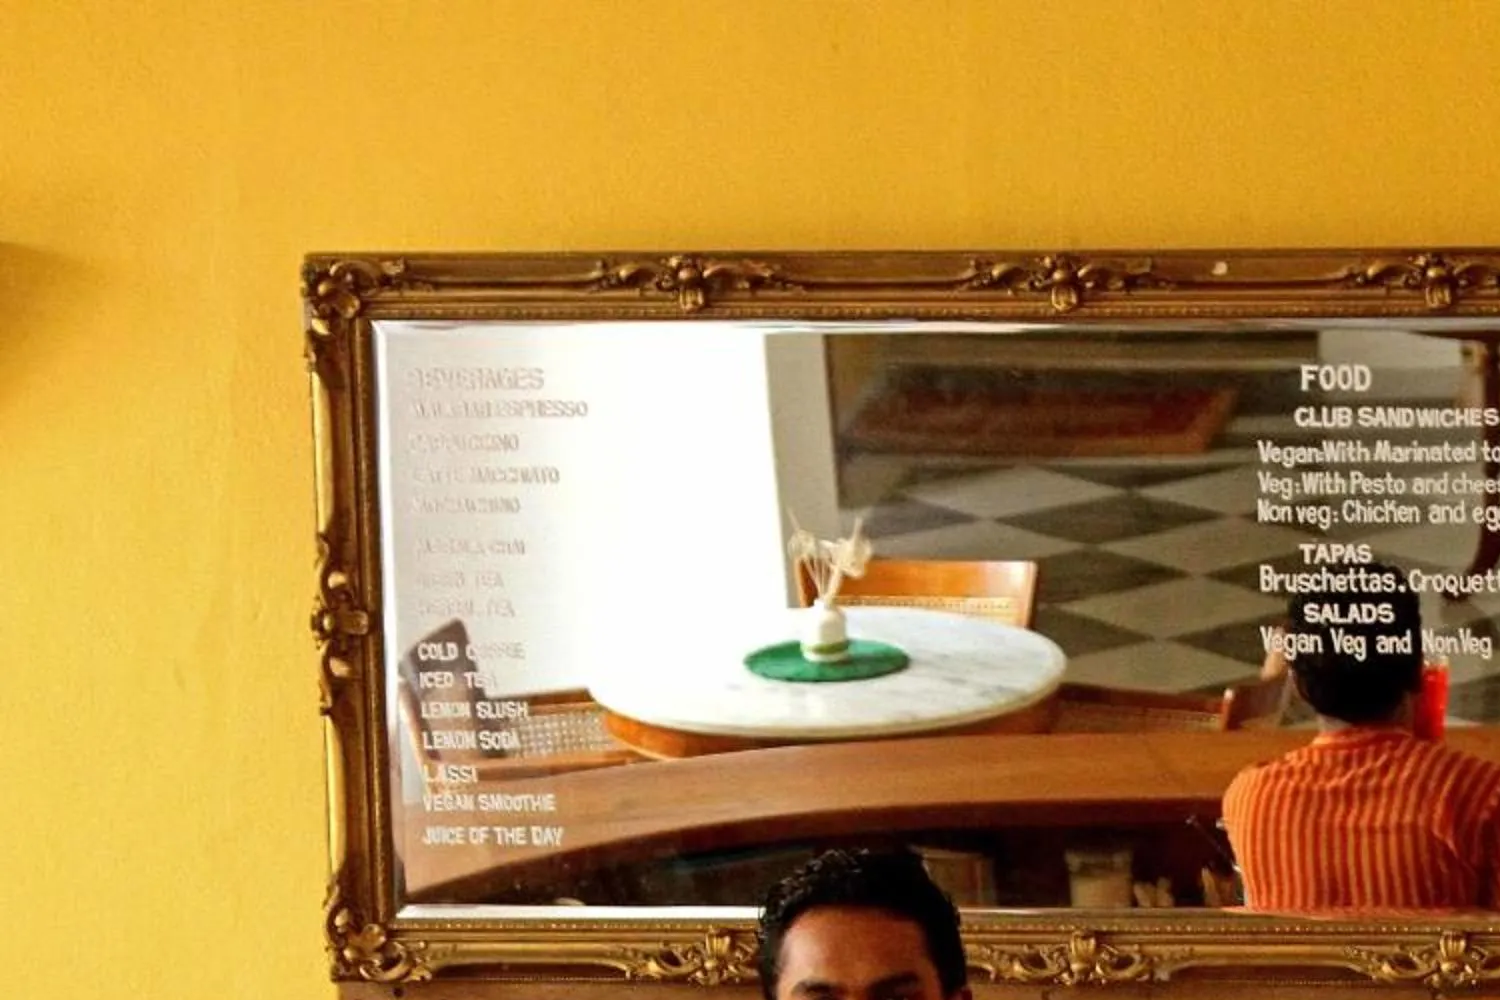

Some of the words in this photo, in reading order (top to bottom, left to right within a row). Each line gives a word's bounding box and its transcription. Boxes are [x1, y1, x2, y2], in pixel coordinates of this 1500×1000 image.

[1300, 364, 1373, 392] FOOD
[1293, 406, 1353, 428] CLUB
[1357, 406, 1500, 429] SANDWICHES
[1373, 439, 1477, 463] Marinated
[1348, 470, 1407, 496] Pesto
[1411, 471, 1449, 495] and
[1257, 498, 1293, 523] Non
[1295, 505, 1339, 530] veg:
[1427, 499, 1467, 525] and
[1300, 543, 1373, 565] TAPAS
[1303, 602, 1396, 624] SALADS
[417, 641, 459, 661] COLD
[1259, 625, 1324, 662] Vegan
[1329, 626, 1368, 662] Veg
[1375, 628, 1412, 655] and
[418, 671, 455, 689] ICED
[421, 700, 471, 719] LEMON
[475, 700, 530, 719] SLUSH
[422, 729, 477, 750] LEMON
[478, 728, 522, 750] SODA
[422, 764, 478, 783] LASSI
[422, 793, 475, 812] VEGAN
[422, 826, 465, 845] JUICE
[468, 826, 490, 844] OF
[492, 826, 527, 845] THE
[530, 826, 564, 846] DAY
